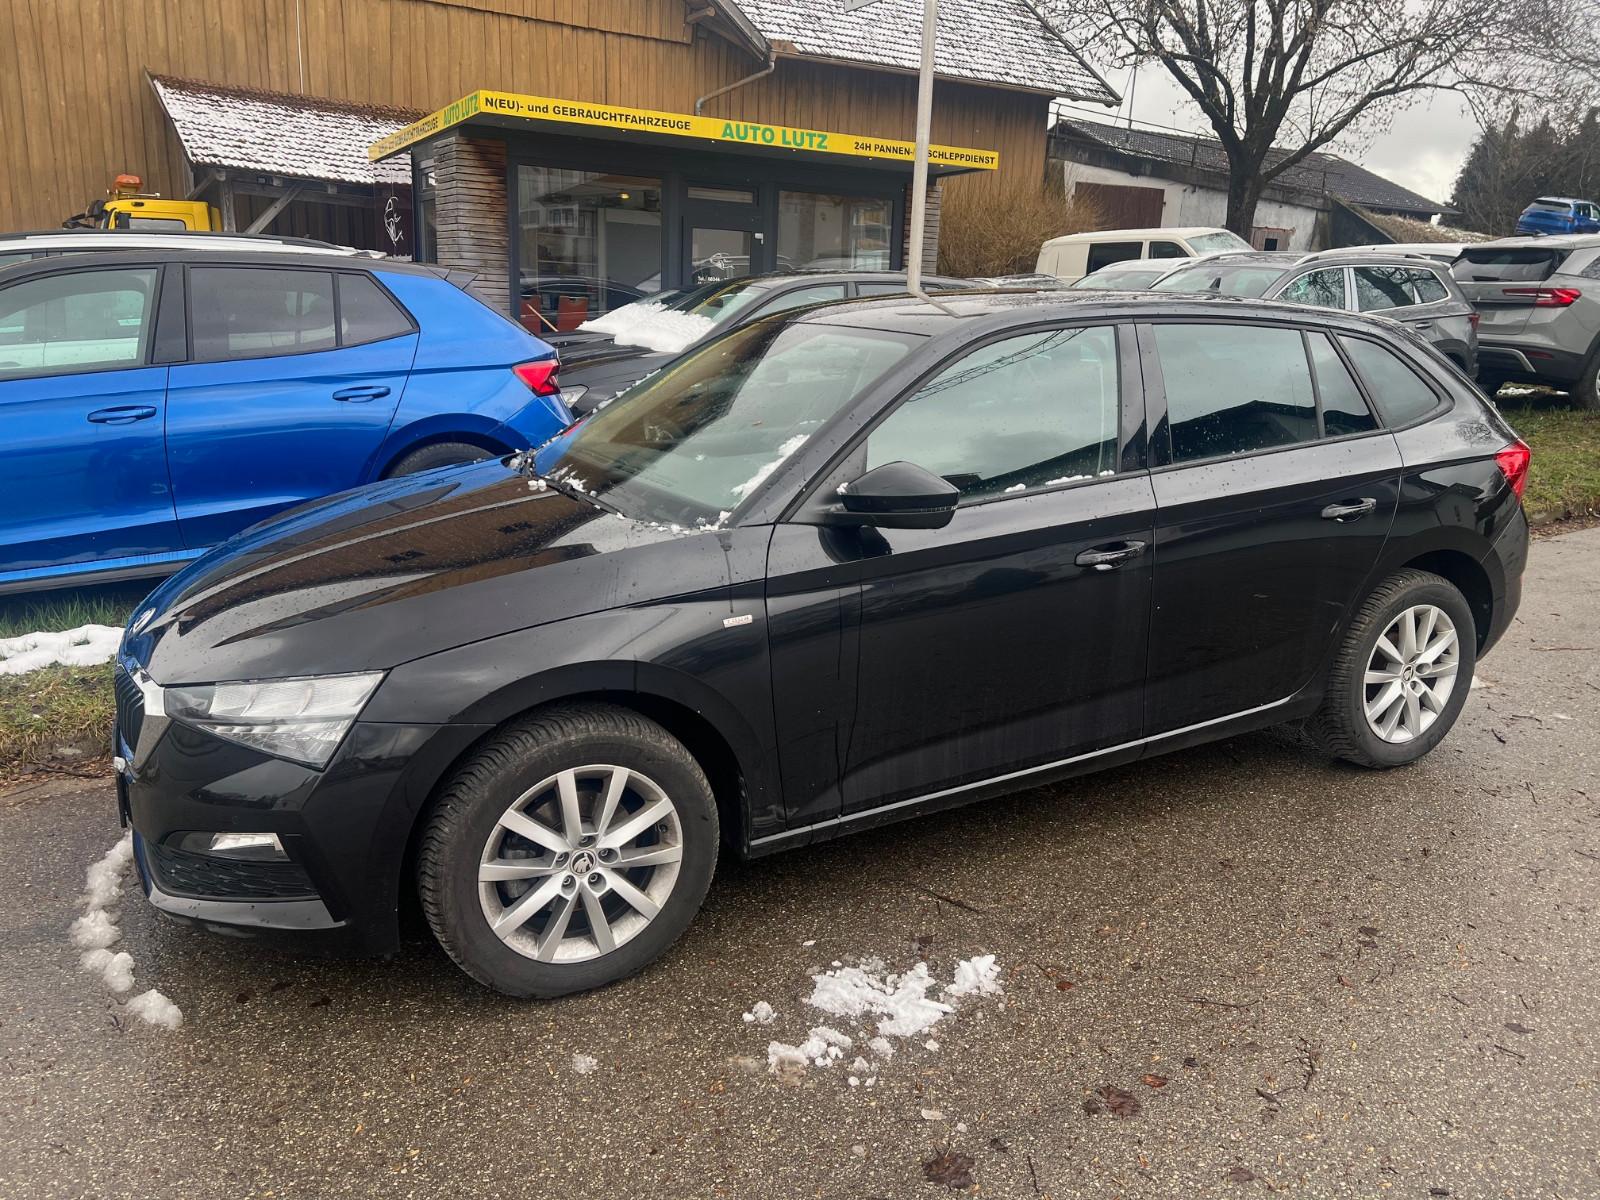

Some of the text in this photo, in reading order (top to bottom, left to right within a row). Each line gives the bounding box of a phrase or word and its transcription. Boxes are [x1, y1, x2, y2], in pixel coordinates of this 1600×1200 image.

[443, 94, 479, 126] AUTO LUTZ
[485, 97, 691, 131] N(EU)- und GEBRAUCHTFAHRZEUGE
[721, 122, 828, 150] AUTO LUTZ
[854, 141, 872, 151] 24H
[874, 144, 913, 156] PANNEN-
